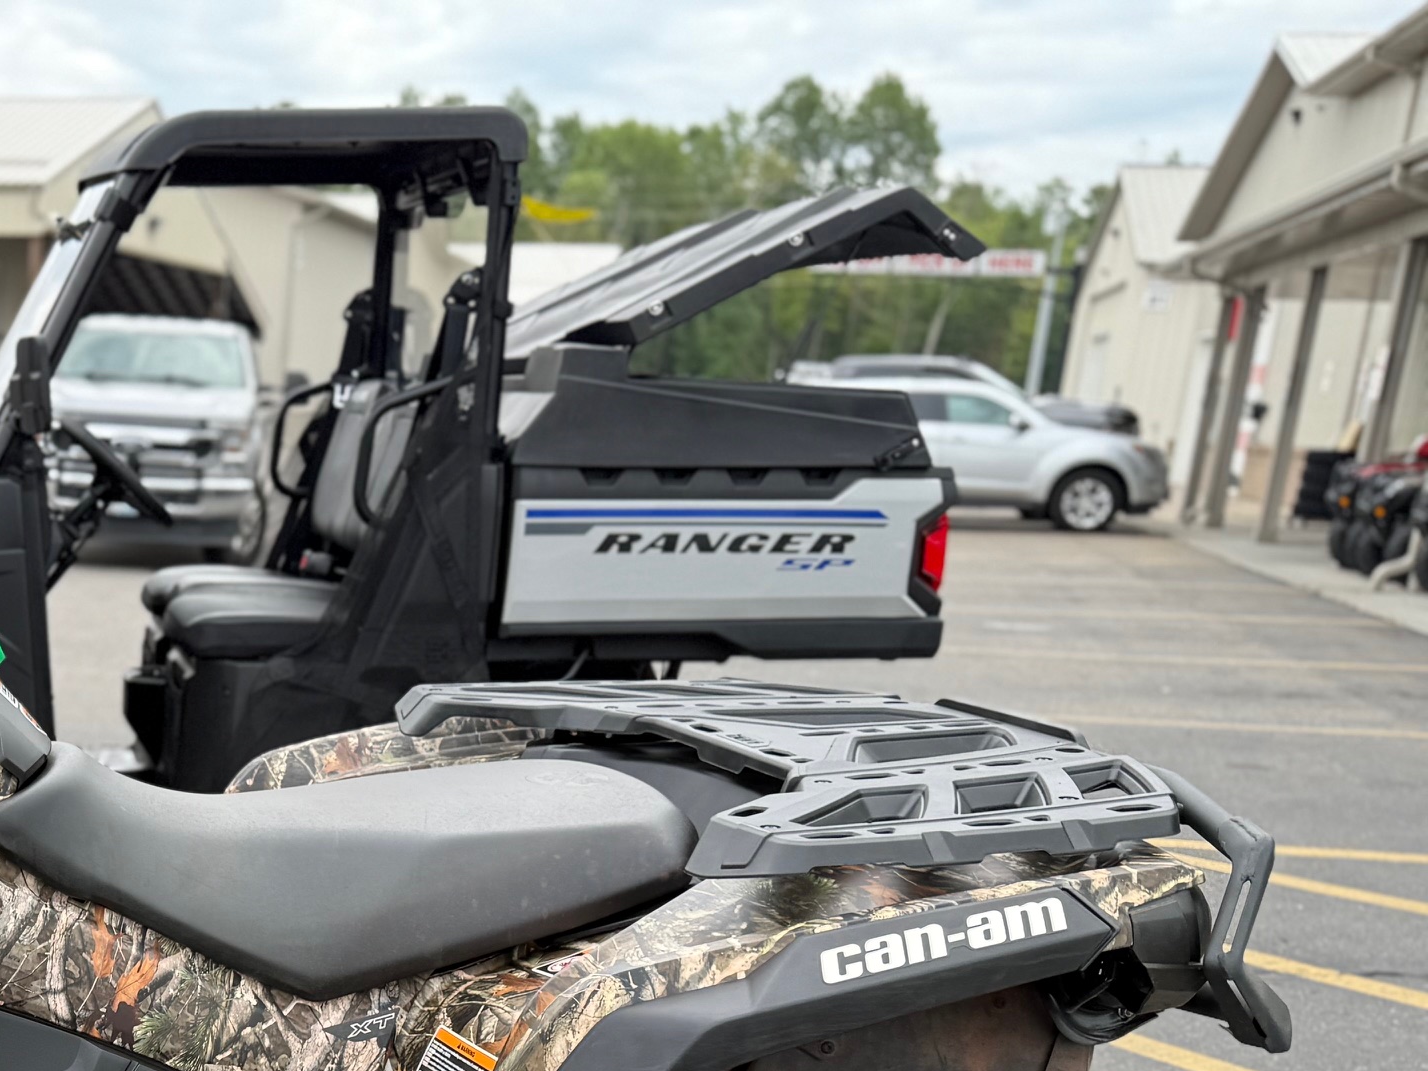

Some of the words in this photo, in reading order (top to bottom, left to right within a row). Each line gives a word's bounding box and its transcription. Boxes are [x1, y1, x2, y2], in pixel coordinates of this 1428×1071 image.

[593, 532, 857, 554] RANGER
[775, 558, 857, 571] SP
[820, 897, 1068, 985] can-am
[347, 1012, 395, 1039] XT
